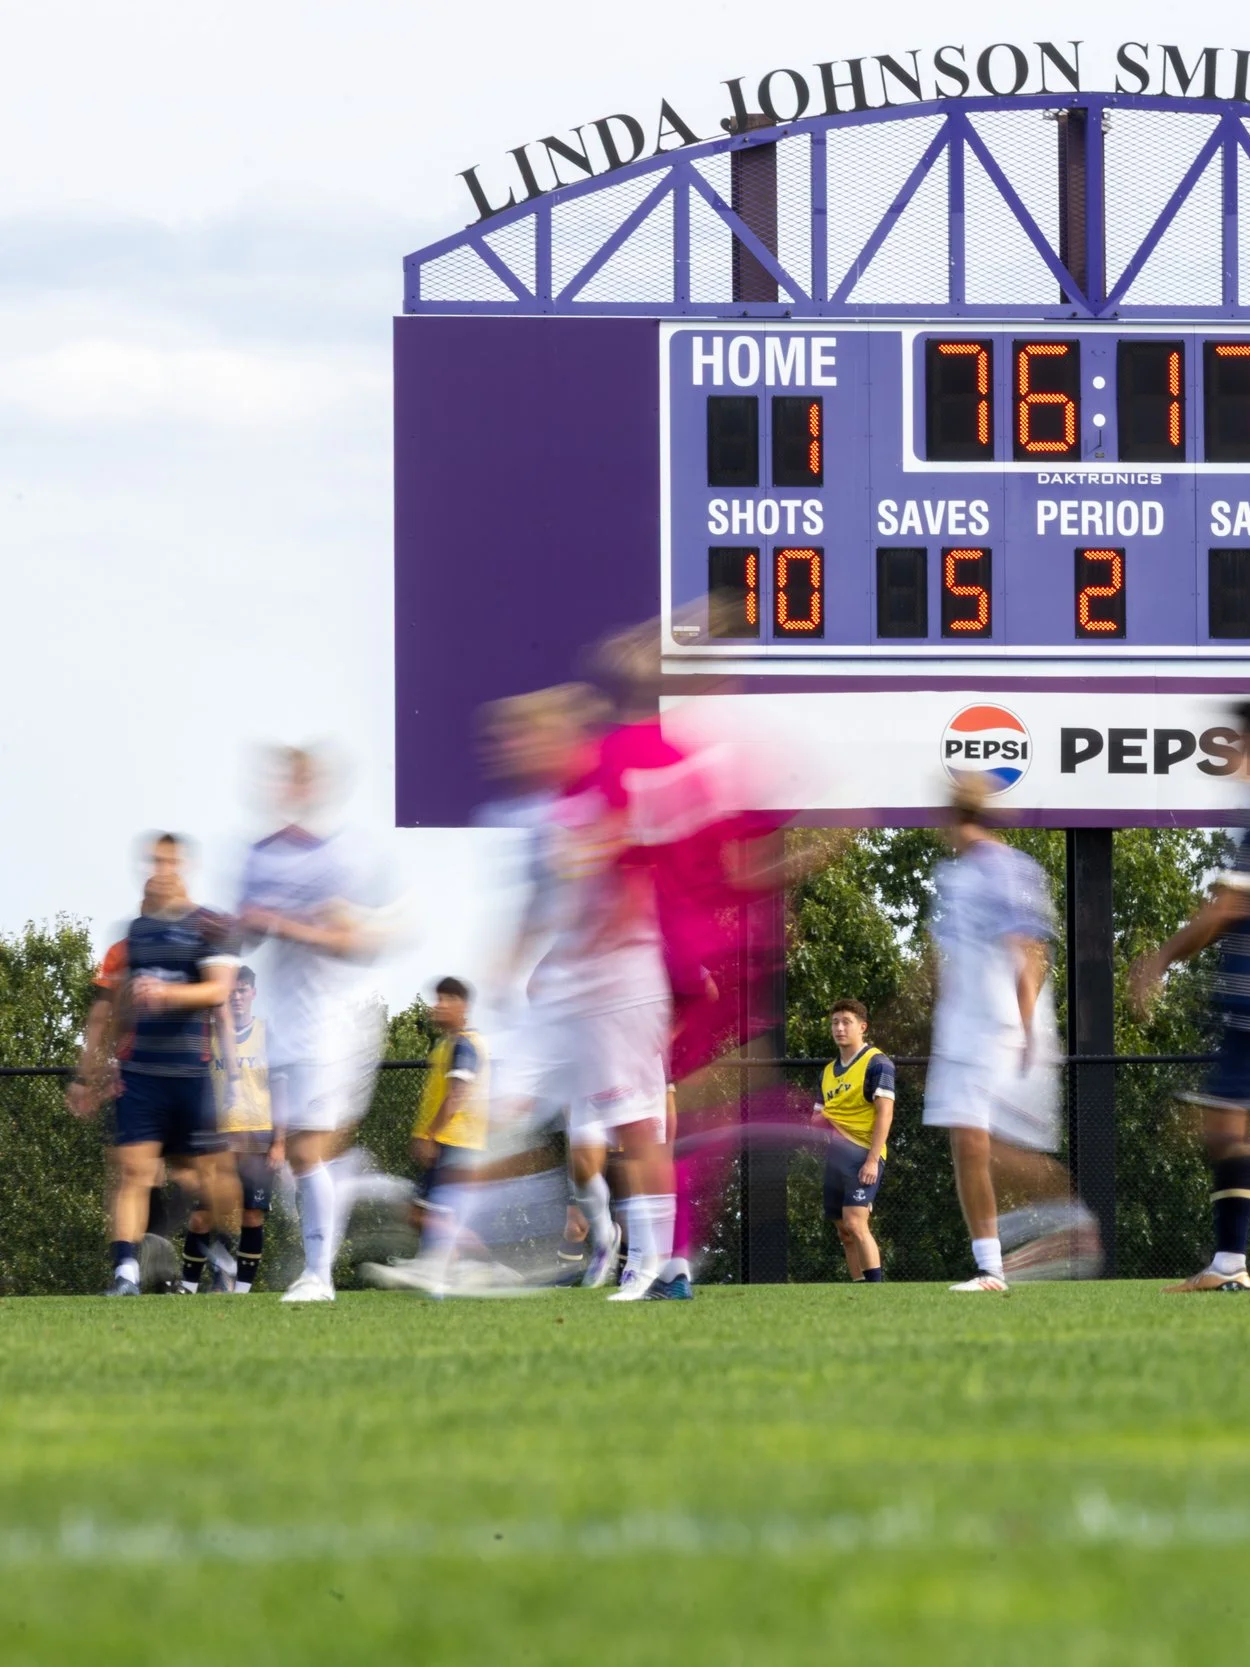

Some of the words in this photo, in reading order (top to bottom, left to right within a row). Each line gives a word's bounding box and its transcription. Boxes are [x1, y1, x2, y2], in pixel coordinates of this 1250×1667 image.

[455, 97, 703, 230] LINDA
[719, 39, 1084, 137] JOHNSON
[692, 336, 838, 387] HOME
[809, 403, 819, 475] 1
[1037, 473, 1162, 485] DAKTRONICS
[708, 499, 824, 536] SHOTS
[877, 499, 990, 536] SAVES
[1036, 500, 1164, 537] PERIOD
[746, 549, 821, 630] 10
[945, 550, 988, 631] 5
[1079, 550, 1122, 631] 2
[945, 739, 1028, 760] PEPSI
[215, 1056, 256, 1071] NVY
